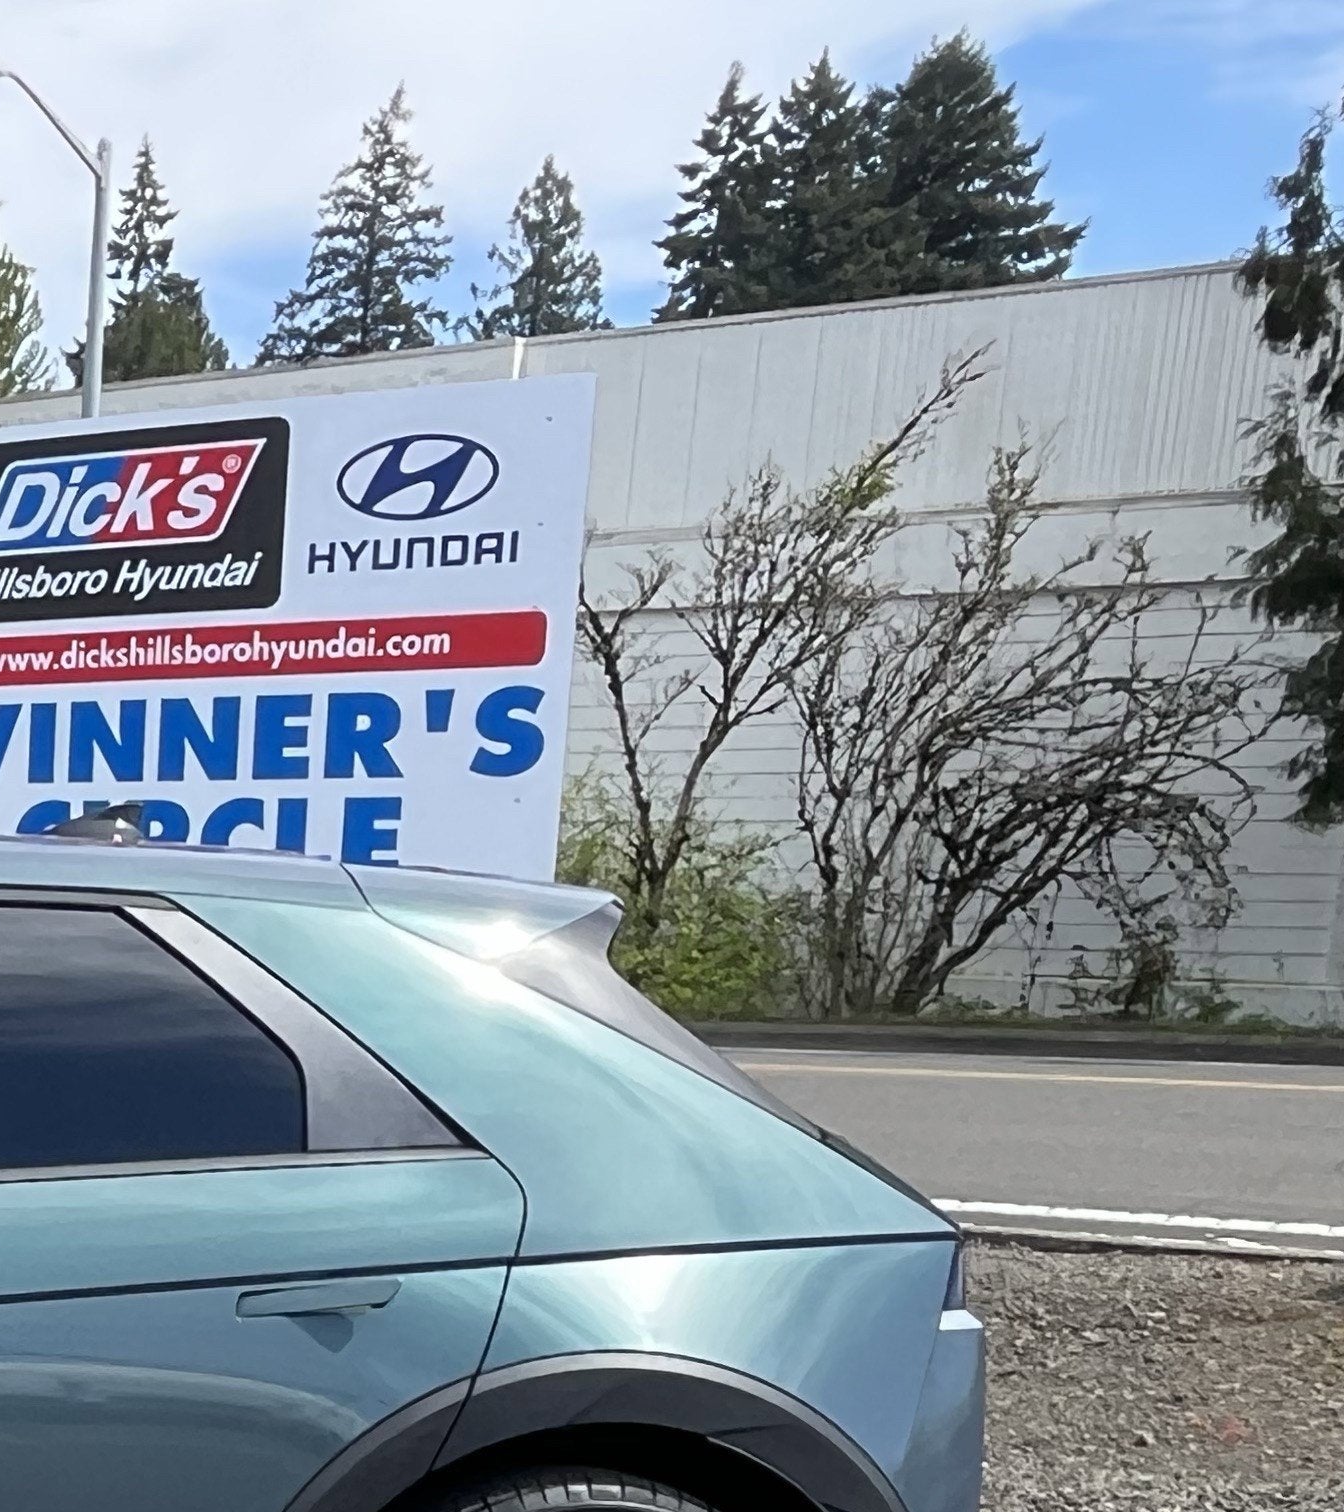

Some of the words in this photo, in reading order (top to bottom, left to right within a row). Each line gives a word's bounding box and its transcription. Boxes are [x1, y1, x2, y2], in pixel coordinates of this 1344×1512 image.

[113, 551, 263, 601] Hyundai
[307, 530, 519, 574] HYUNDAI
[15, 796, 403, 866] CLE
